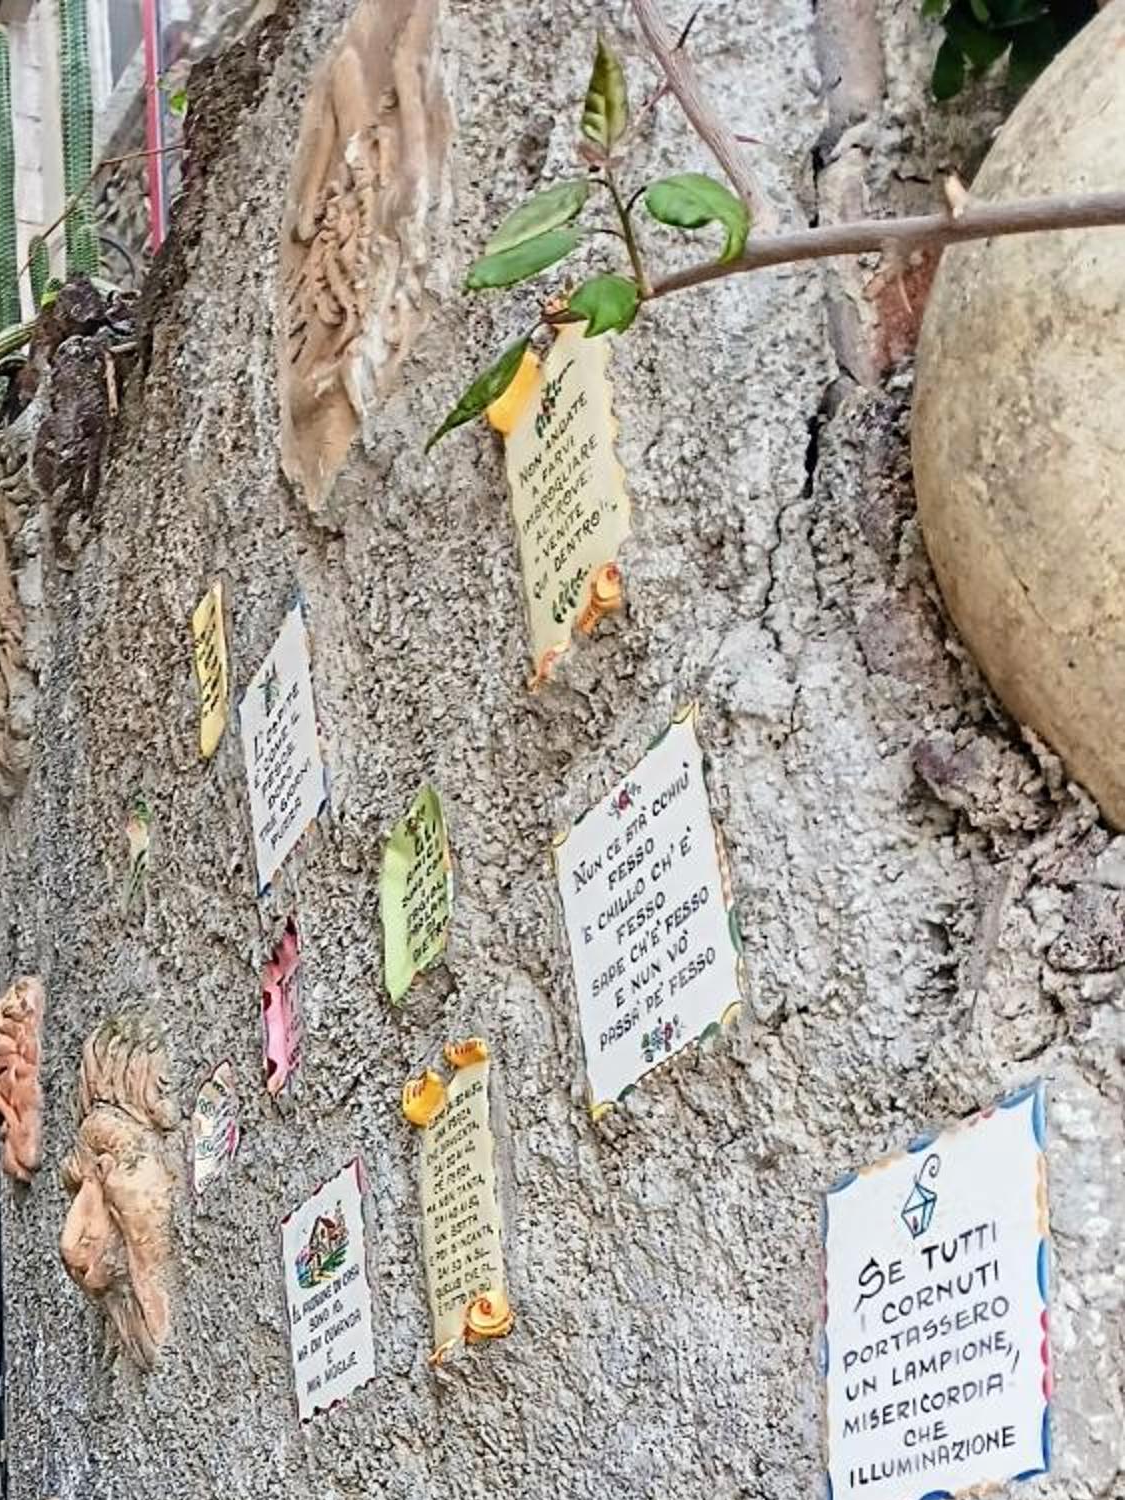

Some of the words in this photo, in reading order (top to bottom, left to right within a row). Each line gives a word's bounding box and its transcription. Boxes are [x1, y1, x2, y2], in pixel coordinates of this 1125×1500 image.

[519, 453, 542, 489] NON
[545, 391, 588, 450] ANDATE
[522, 433, 598, 536] IMBROGLIARE
[573, 853, 603, 895] NUN
[606, 837, 622, 861] CE
[608, 836, 654, 892] FESSO
[598, 877, 645, 930] CHILLO
[616, 890, 666, 945] FESSO
[592, 956, 626, 998] SAPE
[665, 885, 710, 935] FESSO
[668, 946, 716, 997] FESSO
[614, 987, 626, 1009] E
[631, 957, 661, 995] NUN
[854, 1257, 906, 1313] SE
[921, 1221, 998, 1271] TUTTI
[882, 1259, 1000, 1325] CORNUTI
[843, 1295, 1010, 1374] PORTASSERO
[846, 1376, 877, 1402] UN
[892, 1330, 1013, 1387] LAMPIONE,
[849, 1425, 1017, 1489] ILLUMINAZIONE
[903, 1420, 949, 1448] CHE
